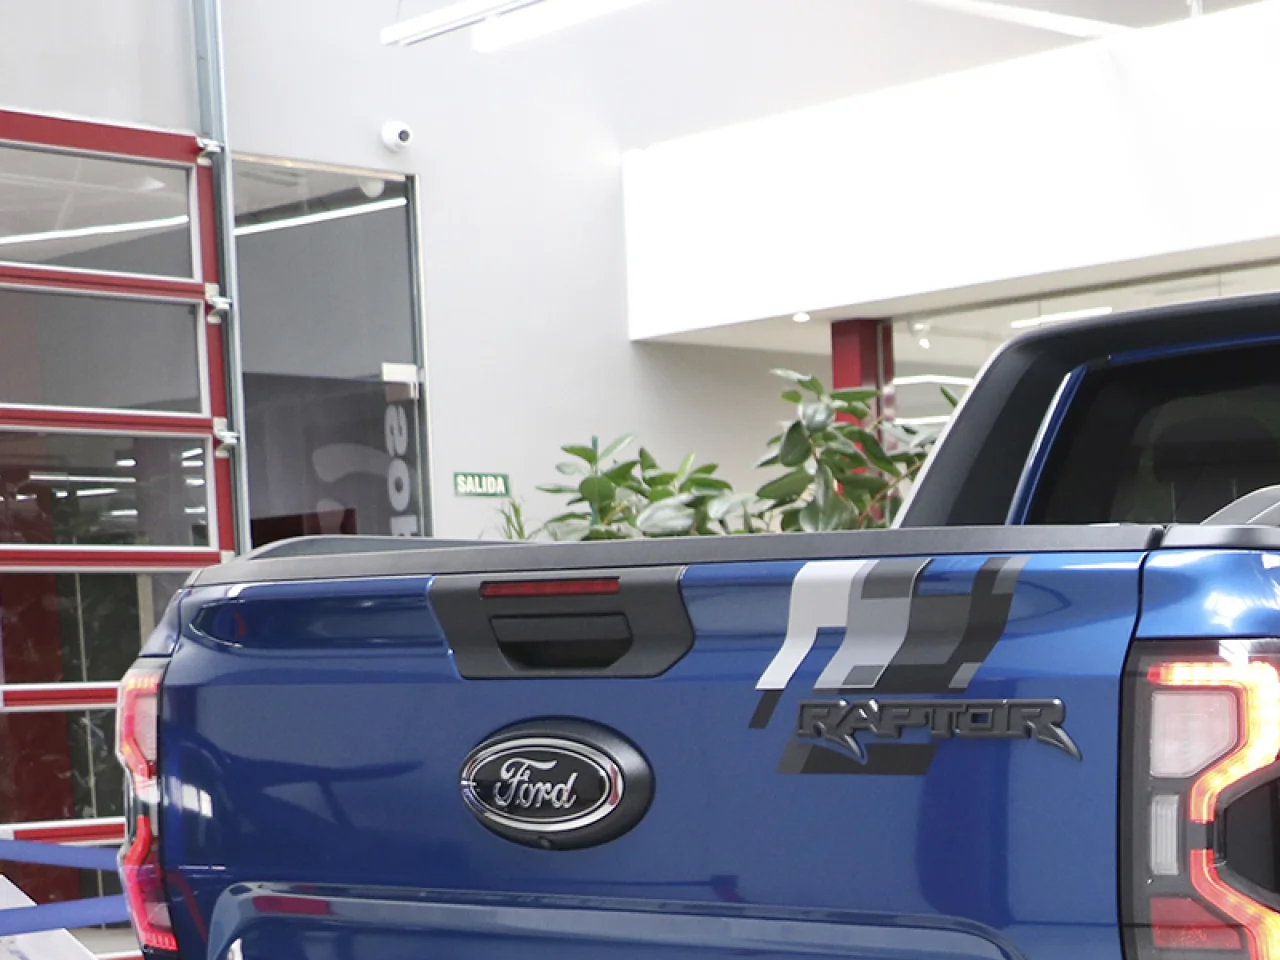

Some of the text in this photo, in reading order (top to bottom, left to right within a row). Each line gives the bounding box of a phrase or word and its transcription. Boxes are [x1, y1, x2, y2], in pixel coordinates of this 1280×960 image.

[455, 474, 505, 494] SALIDA
[797, 698, 1083, 763] RAPTOR
[493, 757, 578, 809] Ford
